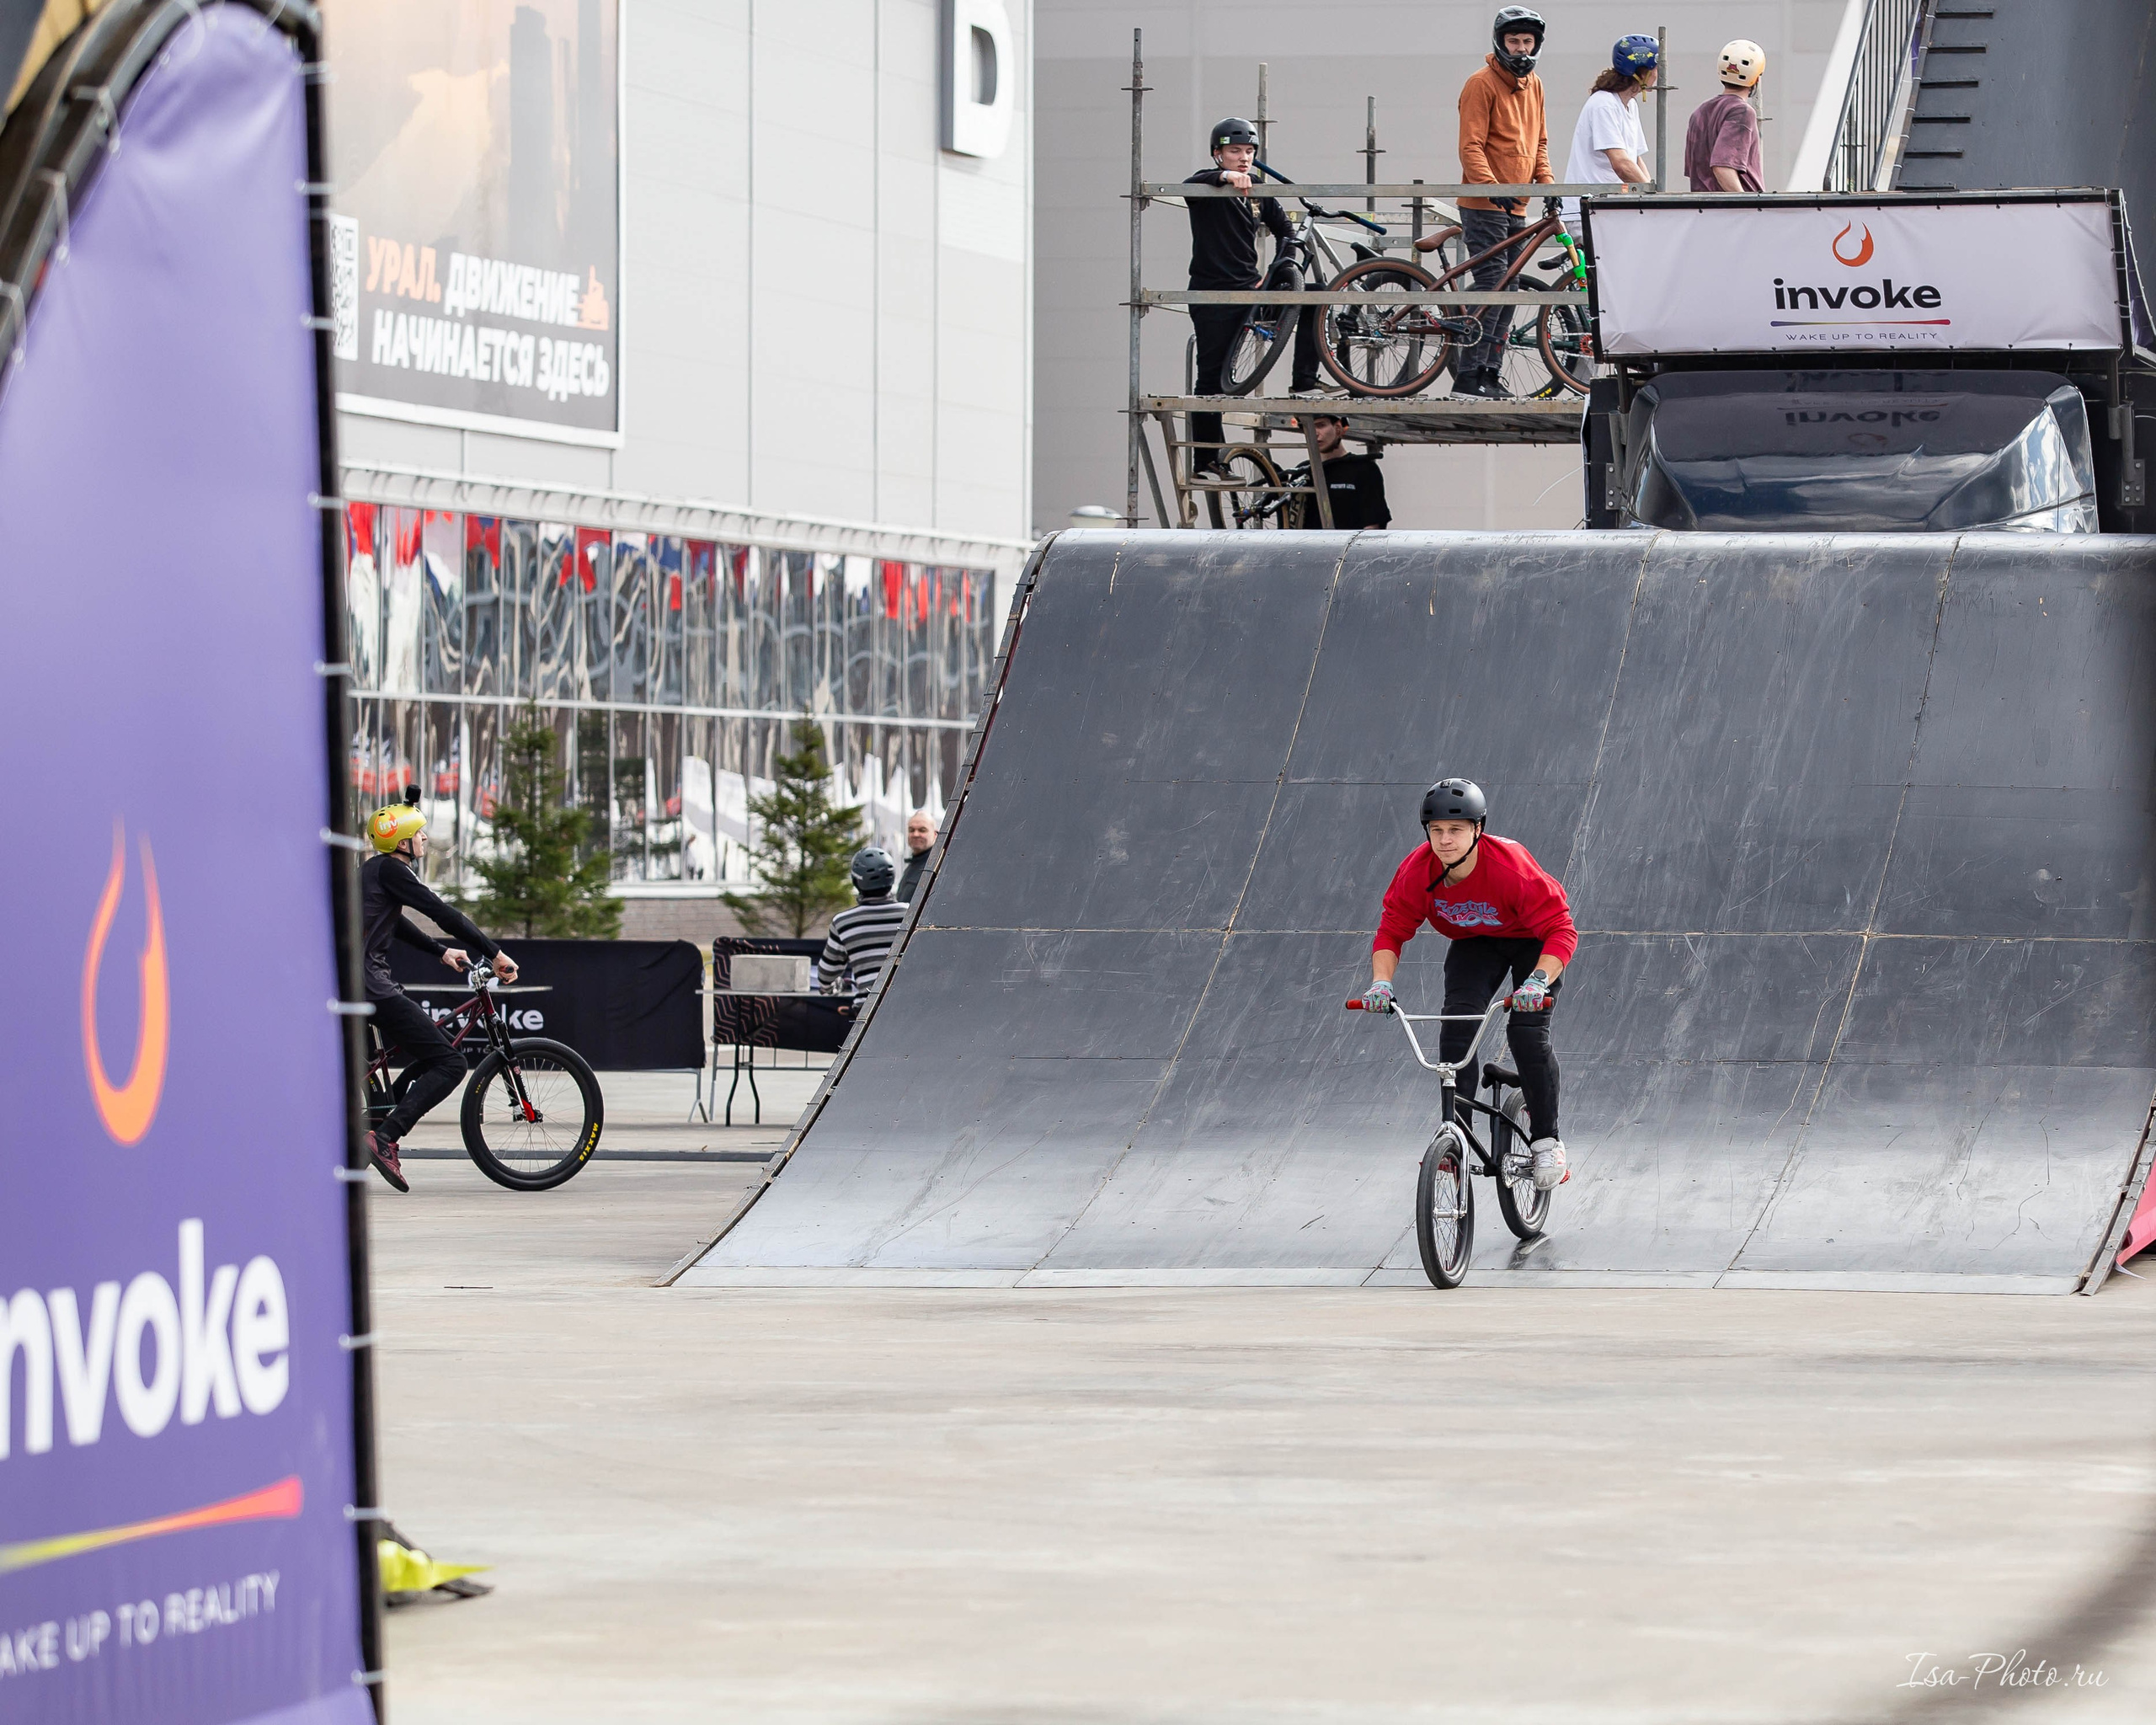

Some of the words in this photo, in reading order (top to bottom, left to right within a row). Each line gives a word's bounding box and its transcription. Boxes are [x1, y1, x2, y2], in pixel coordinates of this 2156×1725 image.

[943, 0, 1015, 158] D
[366, 236, 441, 303] УРАЛ.
[444, 252, 581, 327] ДВИЖЕНИЕ
[1773, 277, 1942, 310] invoke
[371, 309, 535, 387] НАЧИНАЕТСЯ
[536, 338, 610, 403] ЗДЕСЬ
[421, 1000, 544, 1031] invke
[579, 1122, 599, 1162] MAXXIS
[65, 1610, 111, 1663] UP
[116, 1599, 161, 1648] TO
[163, 1568, 281, 1637] REALITY
